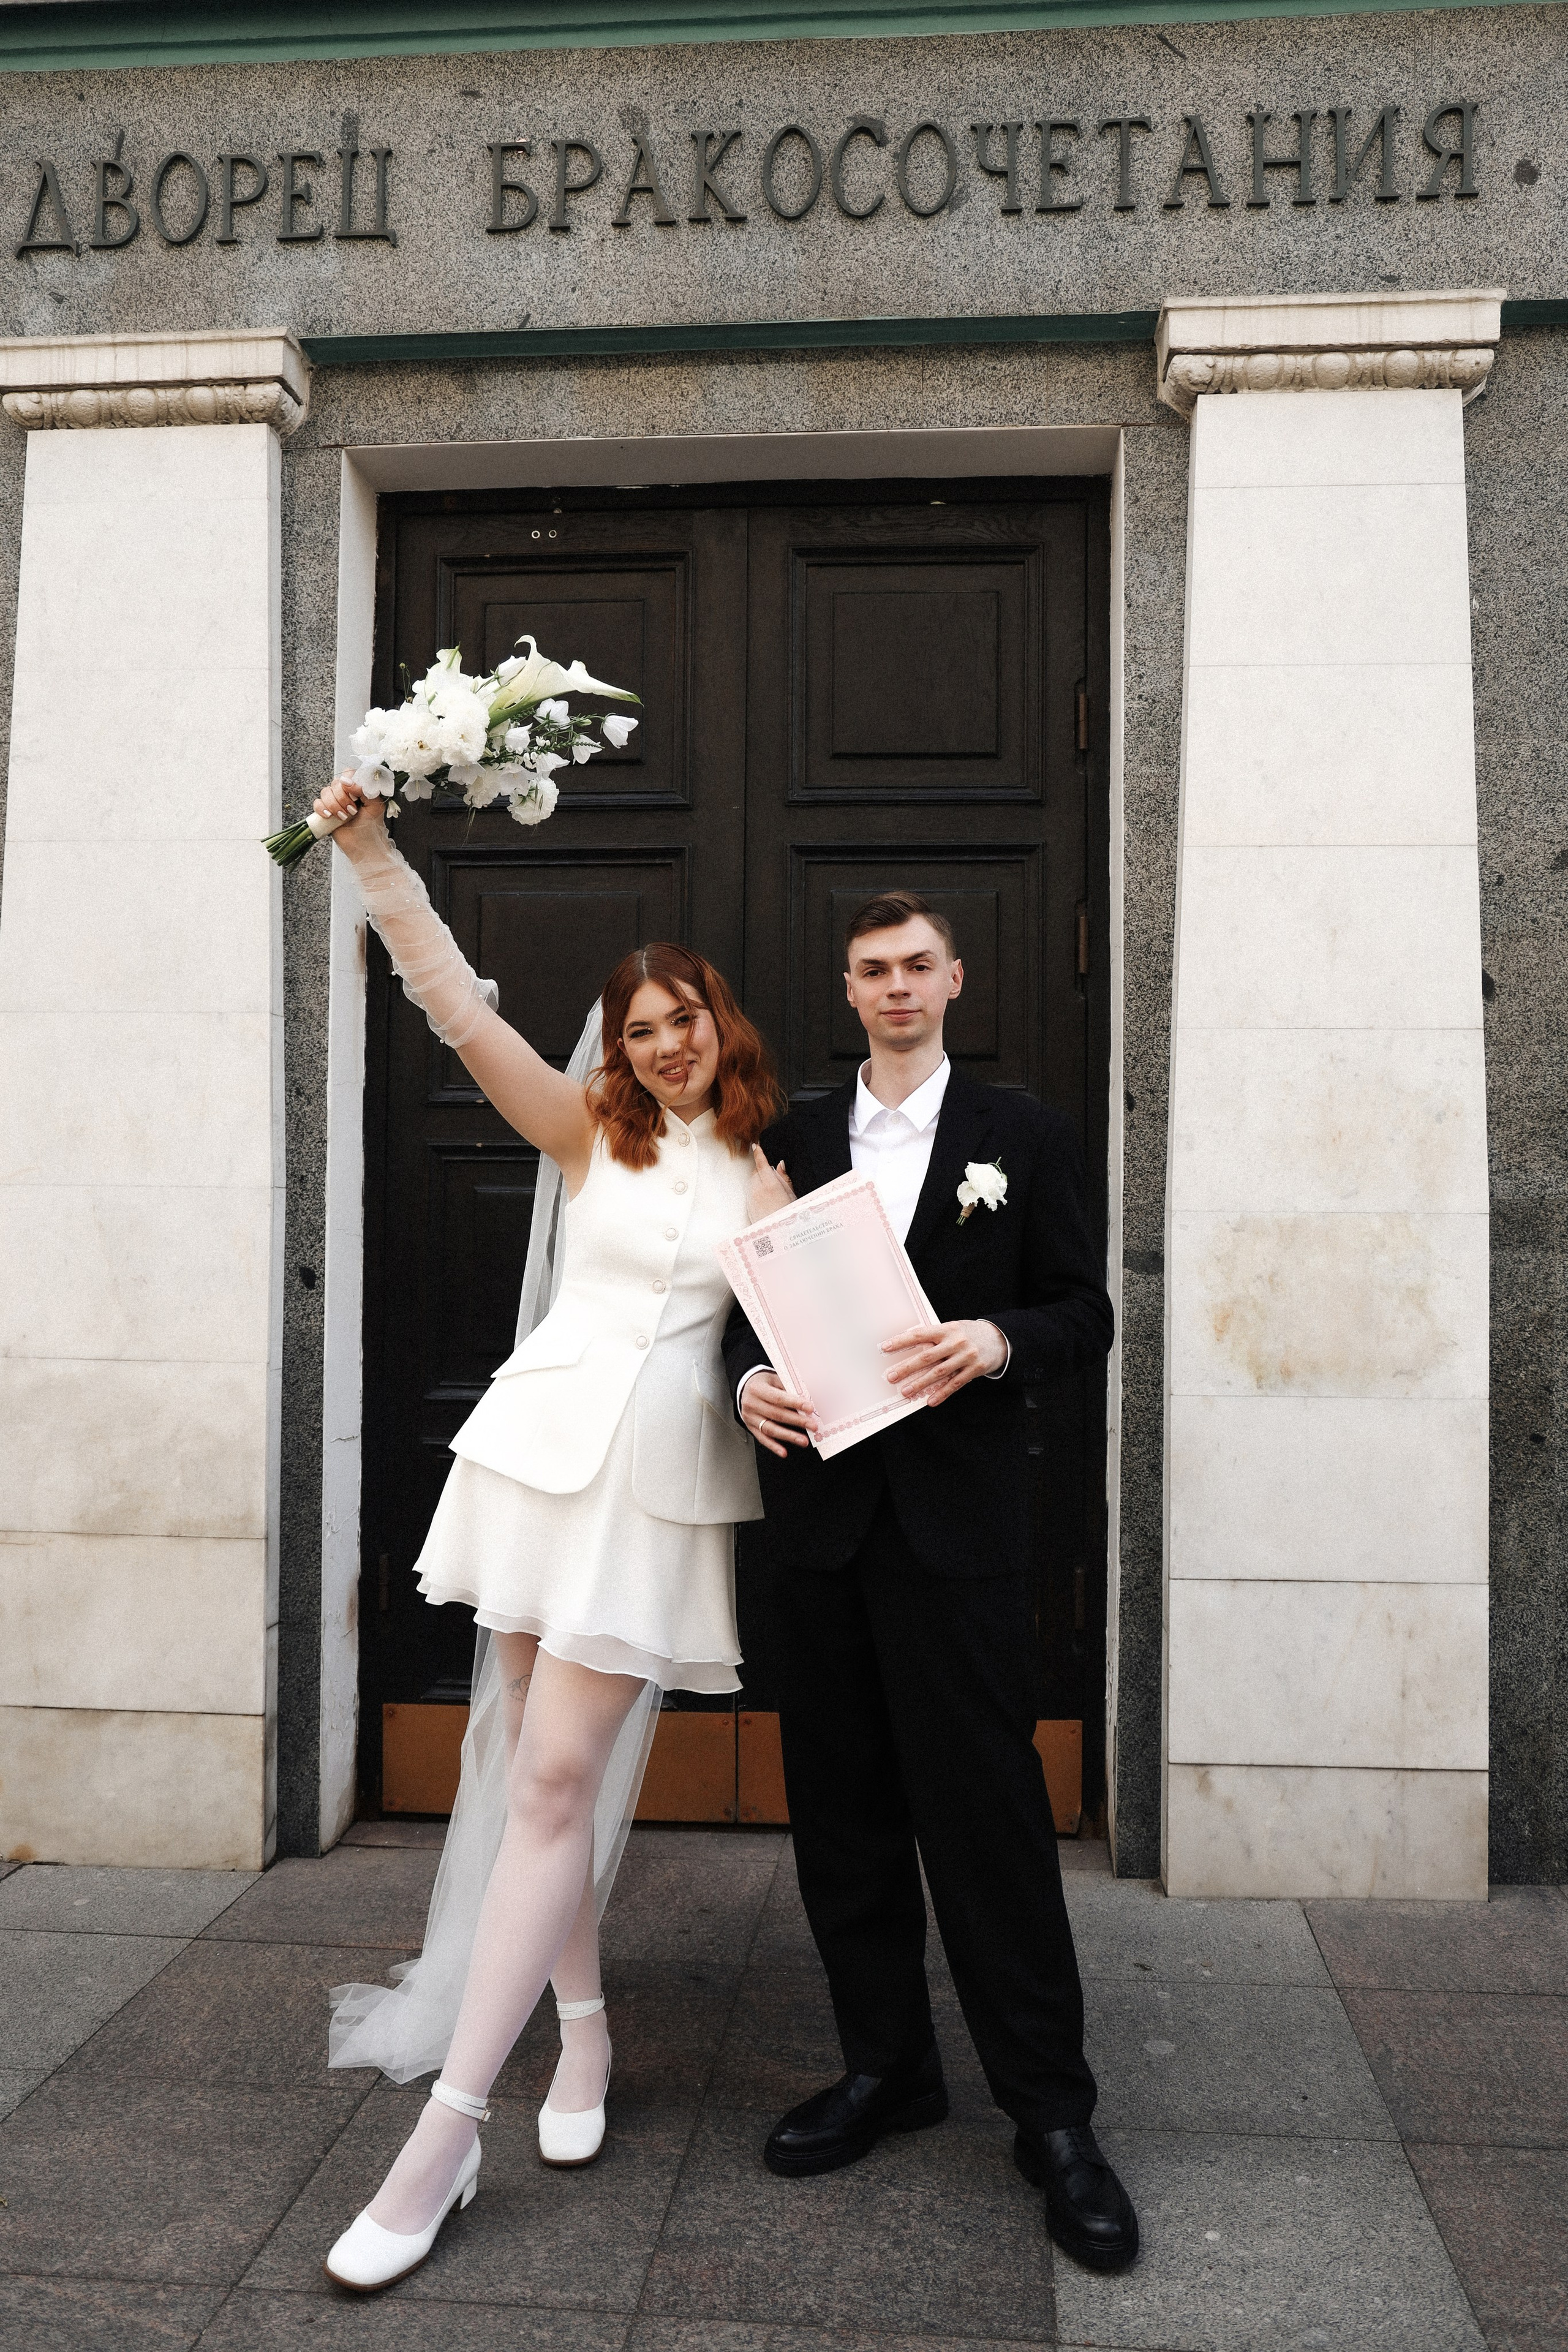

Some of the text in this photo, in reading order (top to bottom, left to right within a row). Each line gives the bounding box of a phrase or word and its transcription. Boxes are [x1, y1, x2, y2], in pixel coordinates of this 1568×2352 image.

[15, 101, 1479, 258] ДВОРЕЦ БРАКОСОЧЕТАНИЯ
[789, 1230, 826, 1248] ЗАКЛЮЧЕНИИ
[826, 1223, 843, 1233] БРАКА
[790, 1220, 832, 1242] СВИДЕТЕЛЬСТВО
